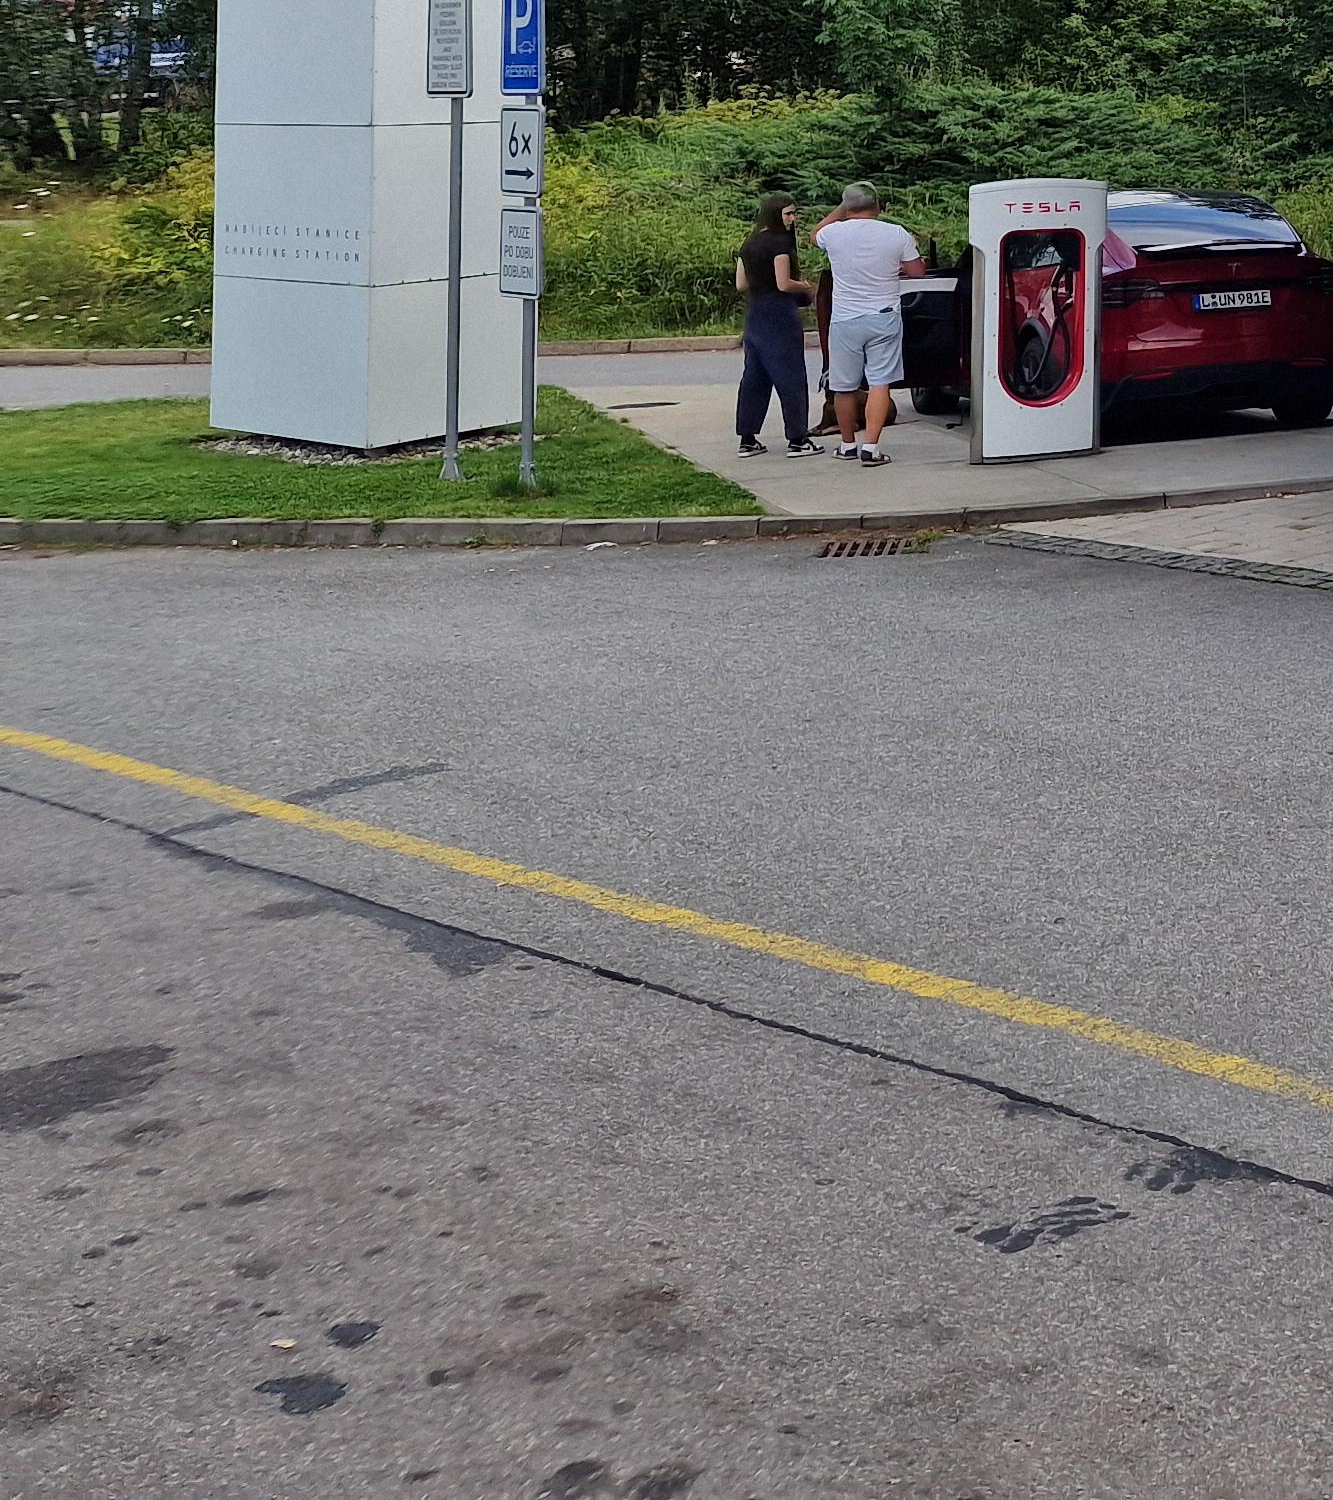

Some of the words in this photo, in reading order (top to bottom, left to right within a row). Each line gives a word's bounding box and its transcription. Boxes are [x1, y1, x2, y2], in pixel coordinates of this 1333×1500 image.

[508, 121, 532, 158] 6x
[1004, 201, 1081, 214] TESLA
[295, 227, 359, 240] STANICE
[508, 225, 530, 239] POUZE
[225, 245, 286, 258] CHARGING
[295, 249, 359, 262] STATION
[504, 244, 513, 257] PO
[515, 245, 533, 259] DOBU
